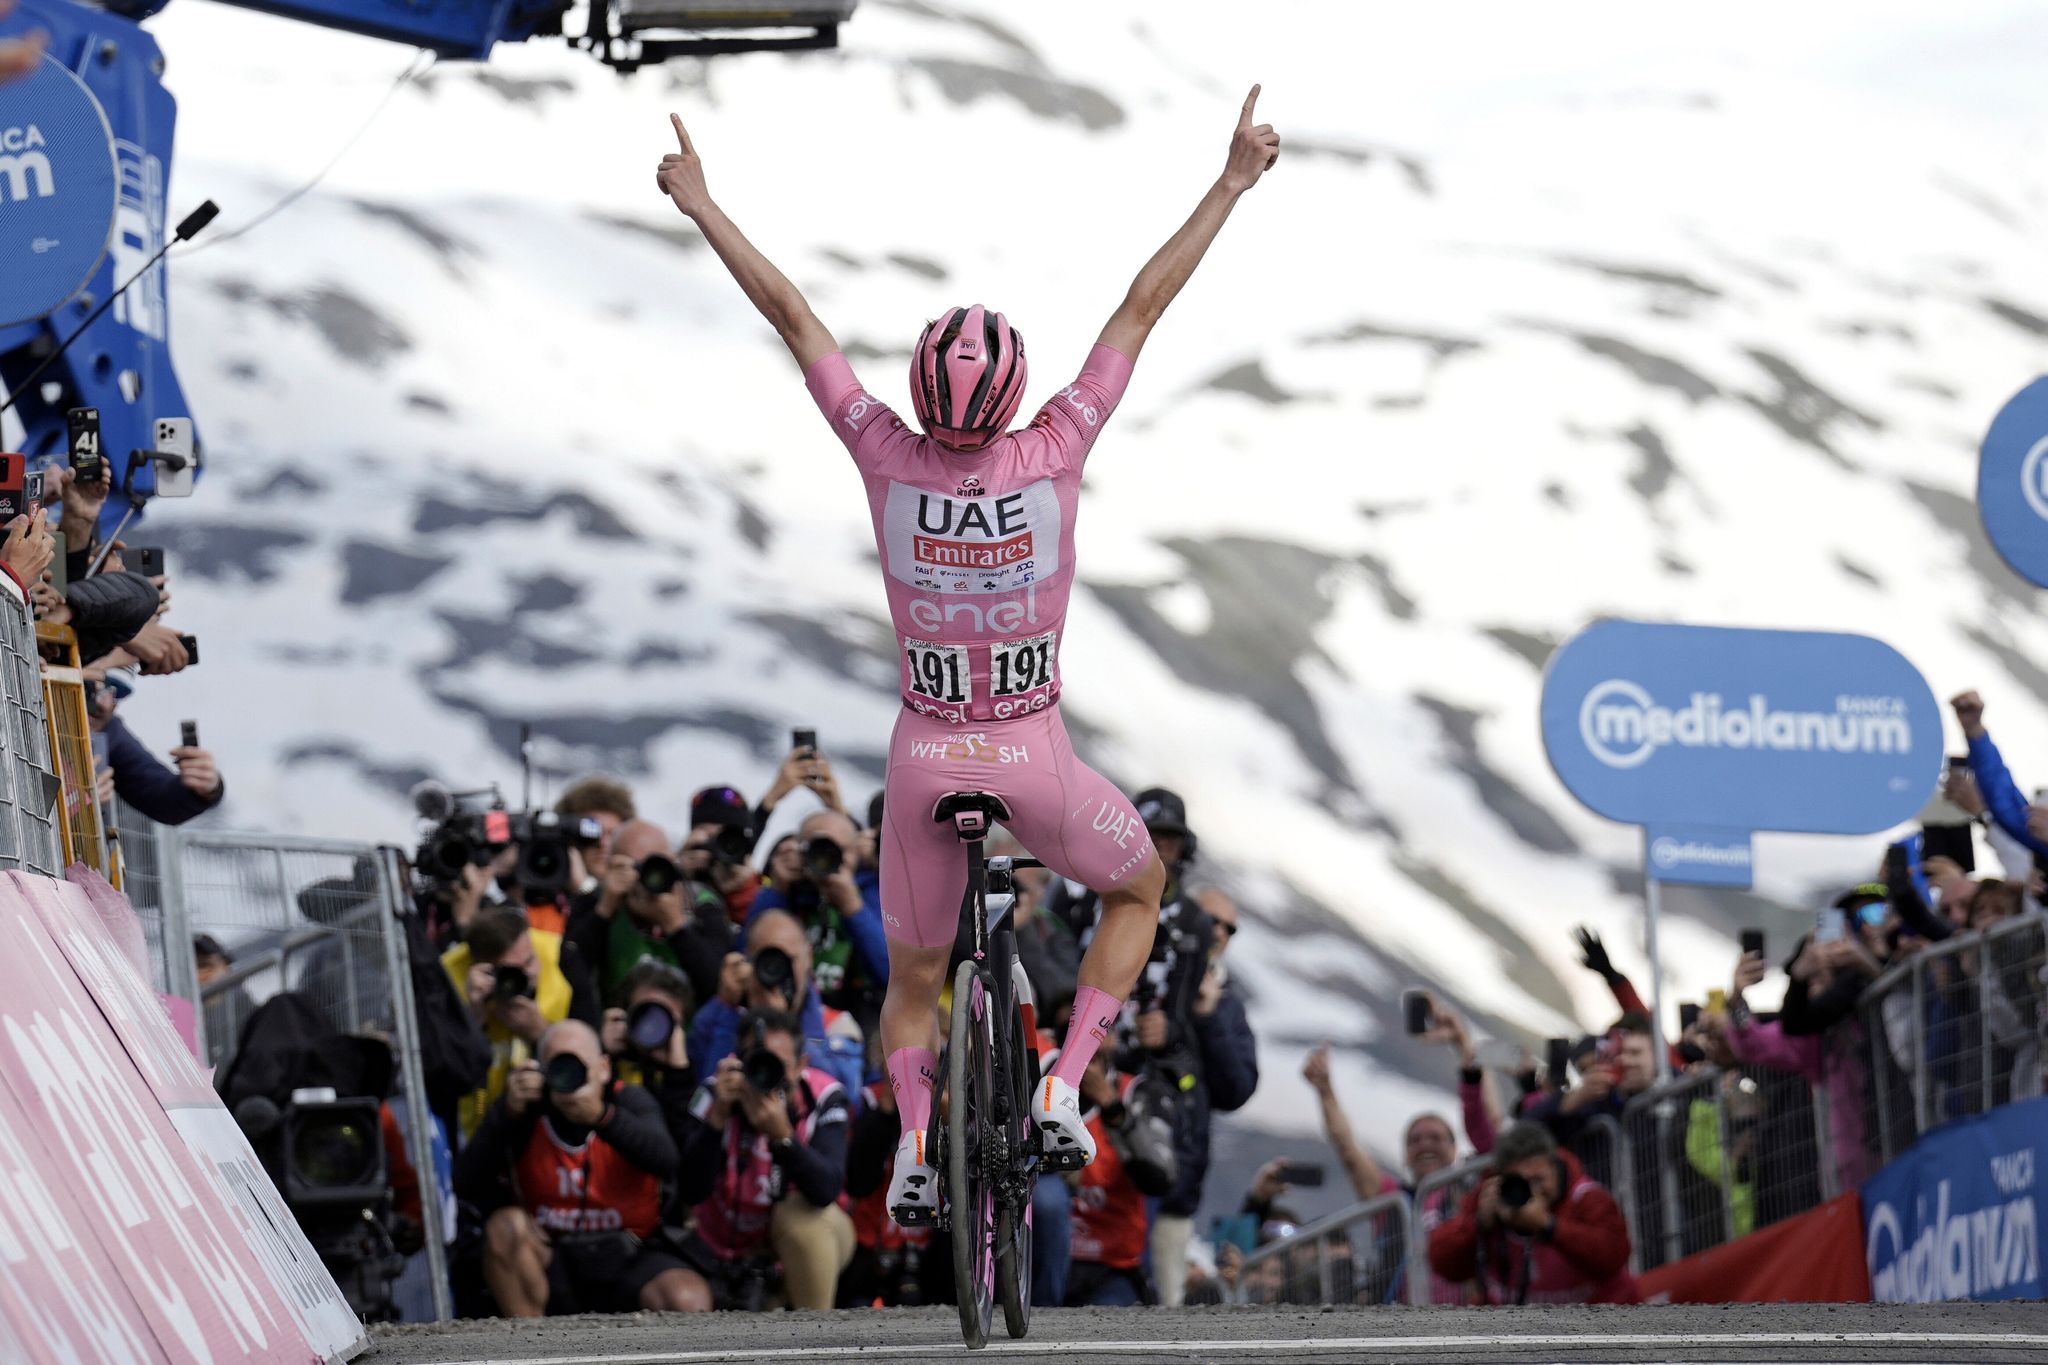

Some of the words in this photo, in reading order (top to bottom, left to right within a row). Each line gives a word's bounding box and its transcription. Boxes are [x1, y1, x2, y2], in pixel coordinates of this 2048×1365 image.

[982, 383, 998, 415] MET
[917, 493, 1027, 538] UAE
[917, 539, 1029, 566] Emirates
[909, 585, 1038, 633] enel
[908, 649, 966, 703] 191
[994, 641, 1051, 695] 191
[913, 700, 967, 724] enel
[994, 685, 1050, 719] enel
[1592, 690, 1912, 756] mediolanum
[1092, 801, 1139, 850] UAE
